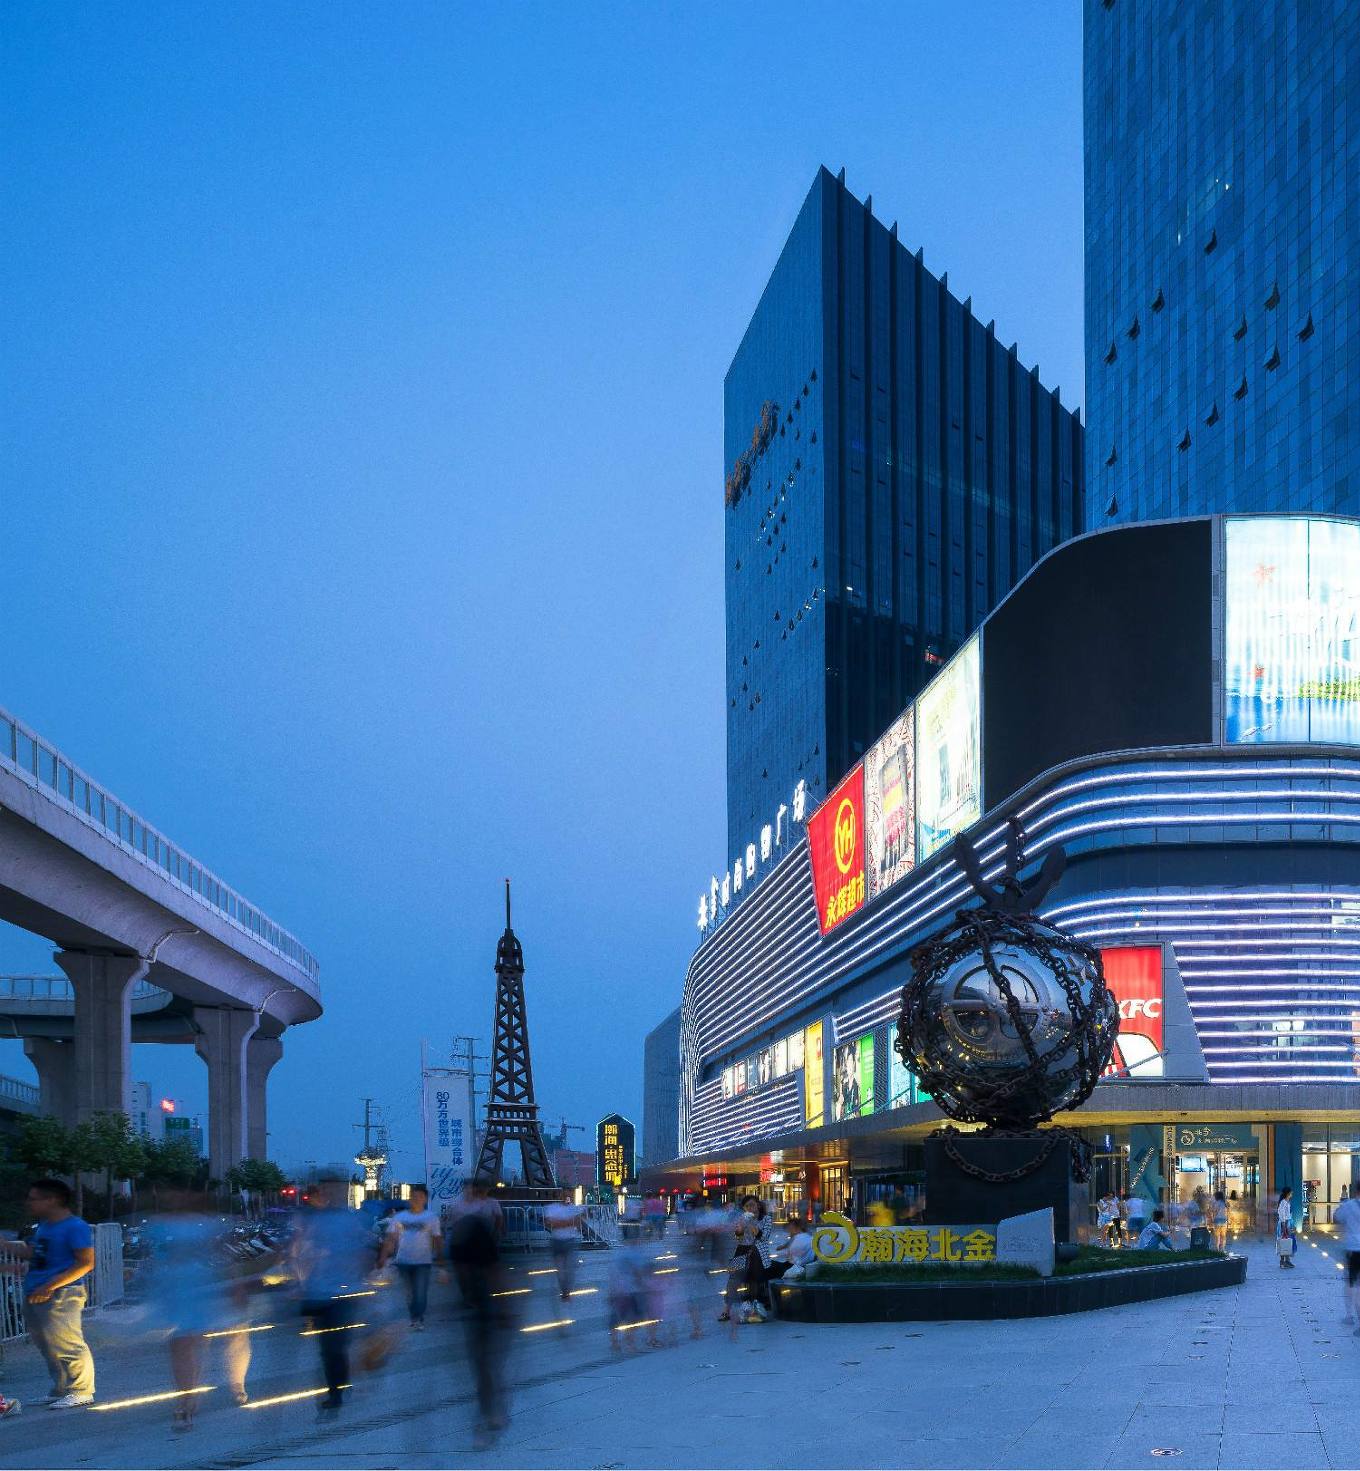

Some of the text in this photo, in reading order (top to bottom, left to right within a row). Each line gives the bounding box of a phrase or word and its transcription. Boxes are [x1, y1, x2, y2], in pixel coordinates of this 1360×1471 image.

[824, 870, 865, 928] 永辉超市
[1118, 998, 1162, 1019] KFC
[858, 1228, 997, 1262] 瀚海北金
